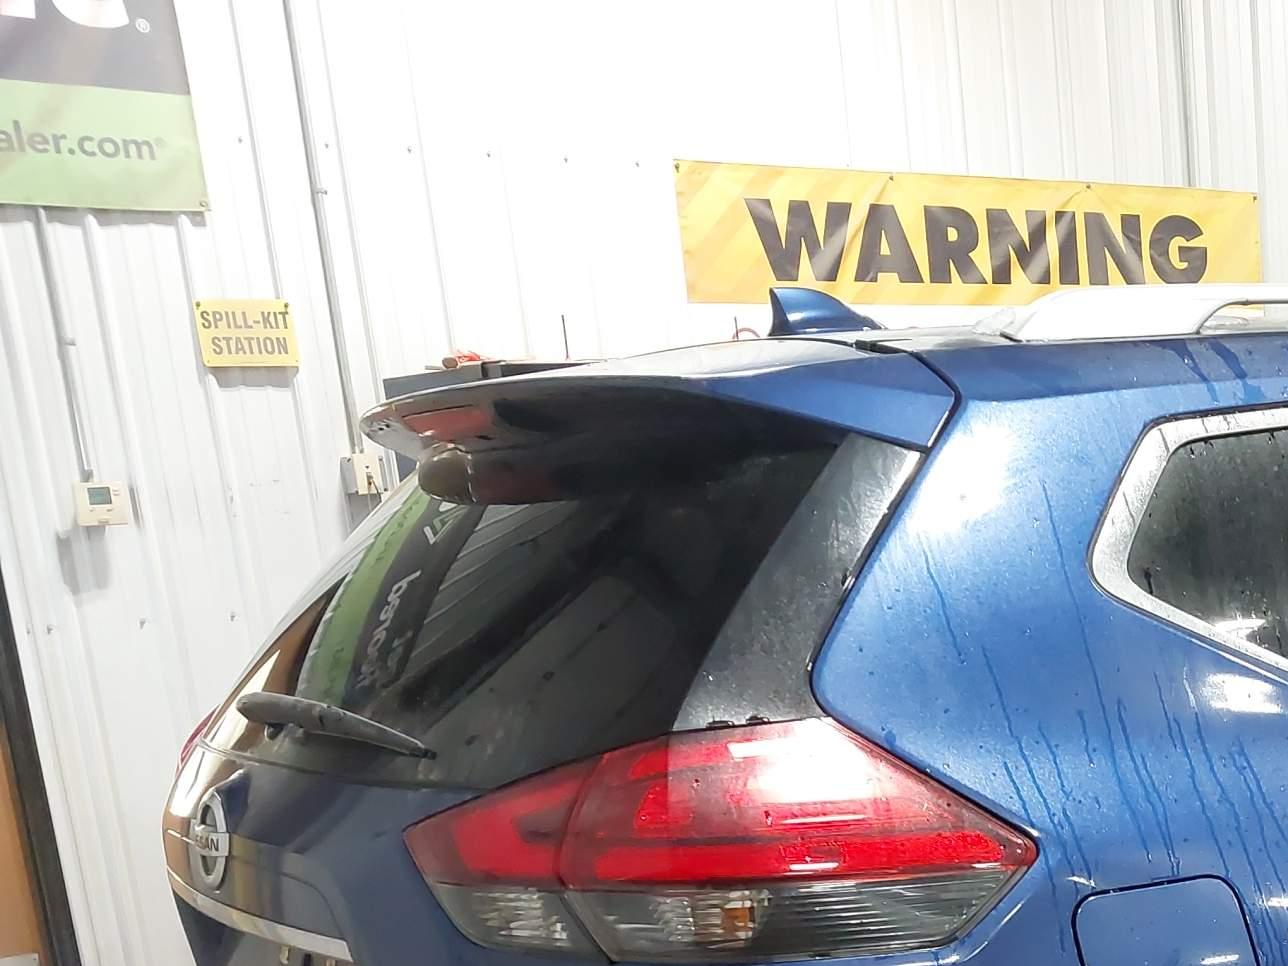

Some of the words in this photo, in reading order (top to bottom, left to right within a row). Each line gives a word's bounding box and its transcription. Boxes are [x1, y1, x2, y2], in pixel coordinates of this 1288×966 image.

[743, 197, 1208, 286] WARNING
[200, 310, 289, 329] SPILL-KIT
[211, 336, 289, 355] STATION
